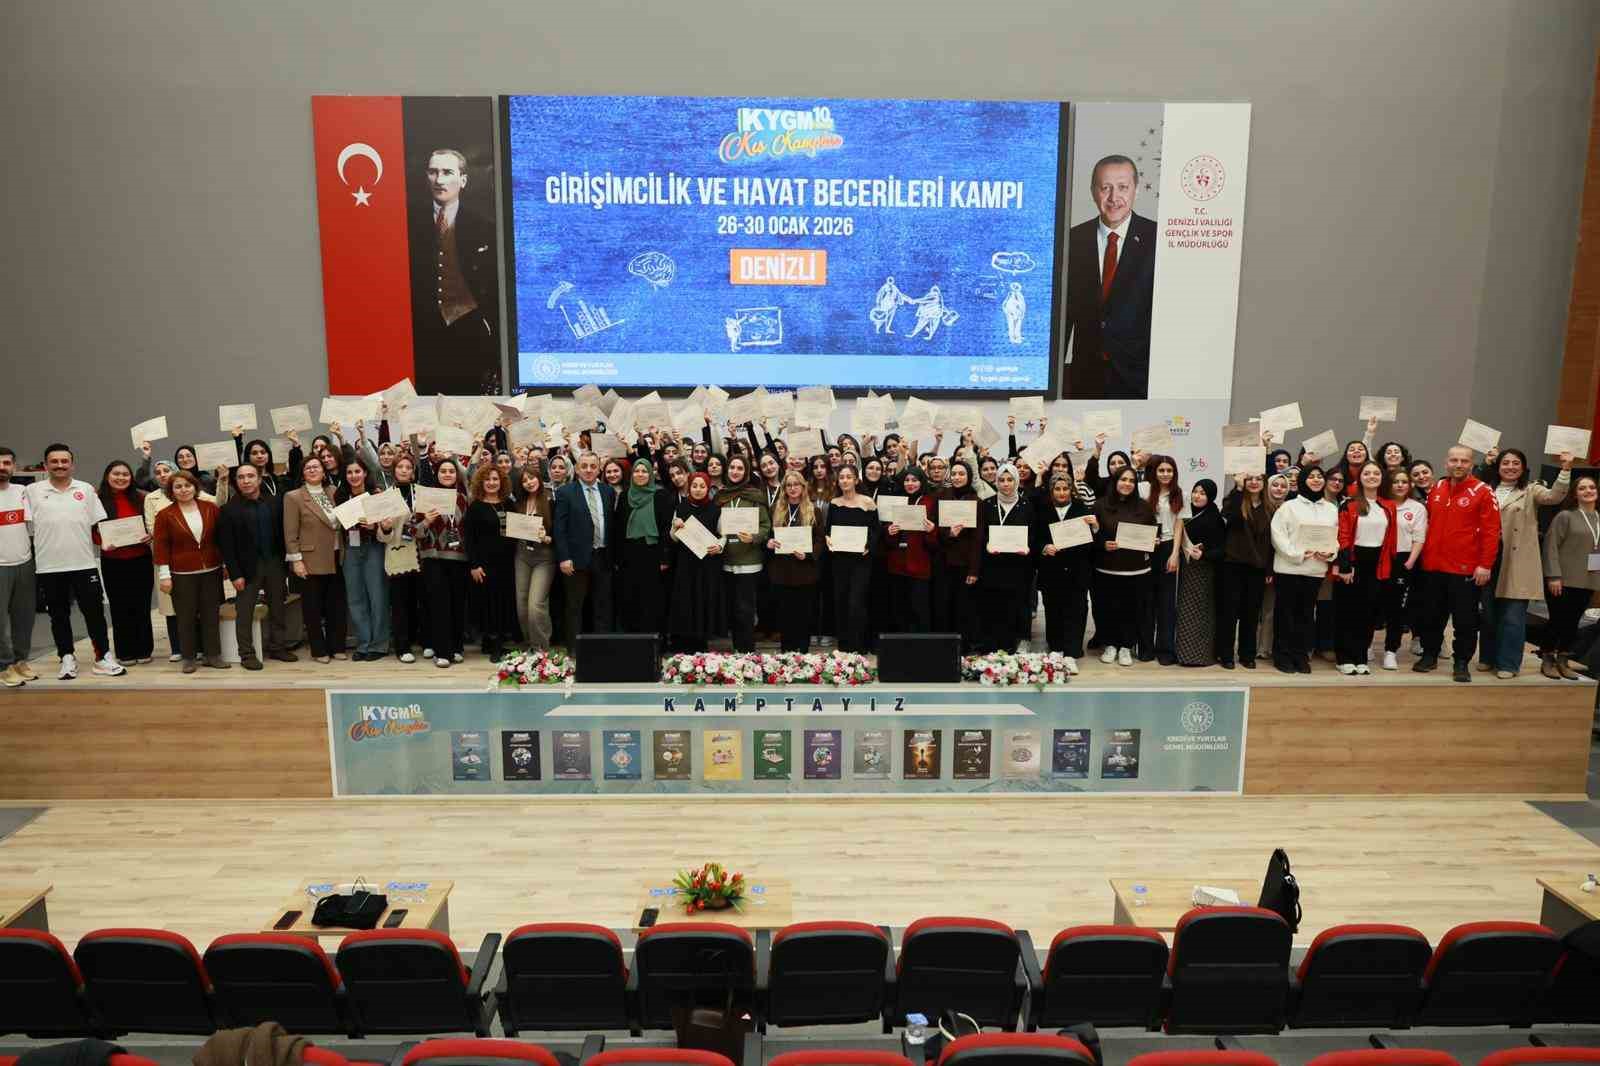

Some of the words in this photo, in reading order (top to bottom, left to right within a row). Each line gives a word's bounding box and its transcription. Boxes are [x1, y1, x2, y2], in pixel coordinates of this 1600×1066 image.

[742, 108, 812, 131] KYGM
[545, 172, 692, 209] GİRİŞİMCİLİK
[698, 177, 727, 206] VE
[733, 177, 808, 207] HAYAT
[814, 175, 943, 208] BECERİLERİ
[950, 180, 1024, 209] KAMPI
[717, 215, 764, 235] 26-30
[768, 215, 810, 236] OCAK
[813, 216, 854, 236] 2026
[740, 252, 816, 281] DENİZLİ
[361, 705, 409, 720] KYGM
